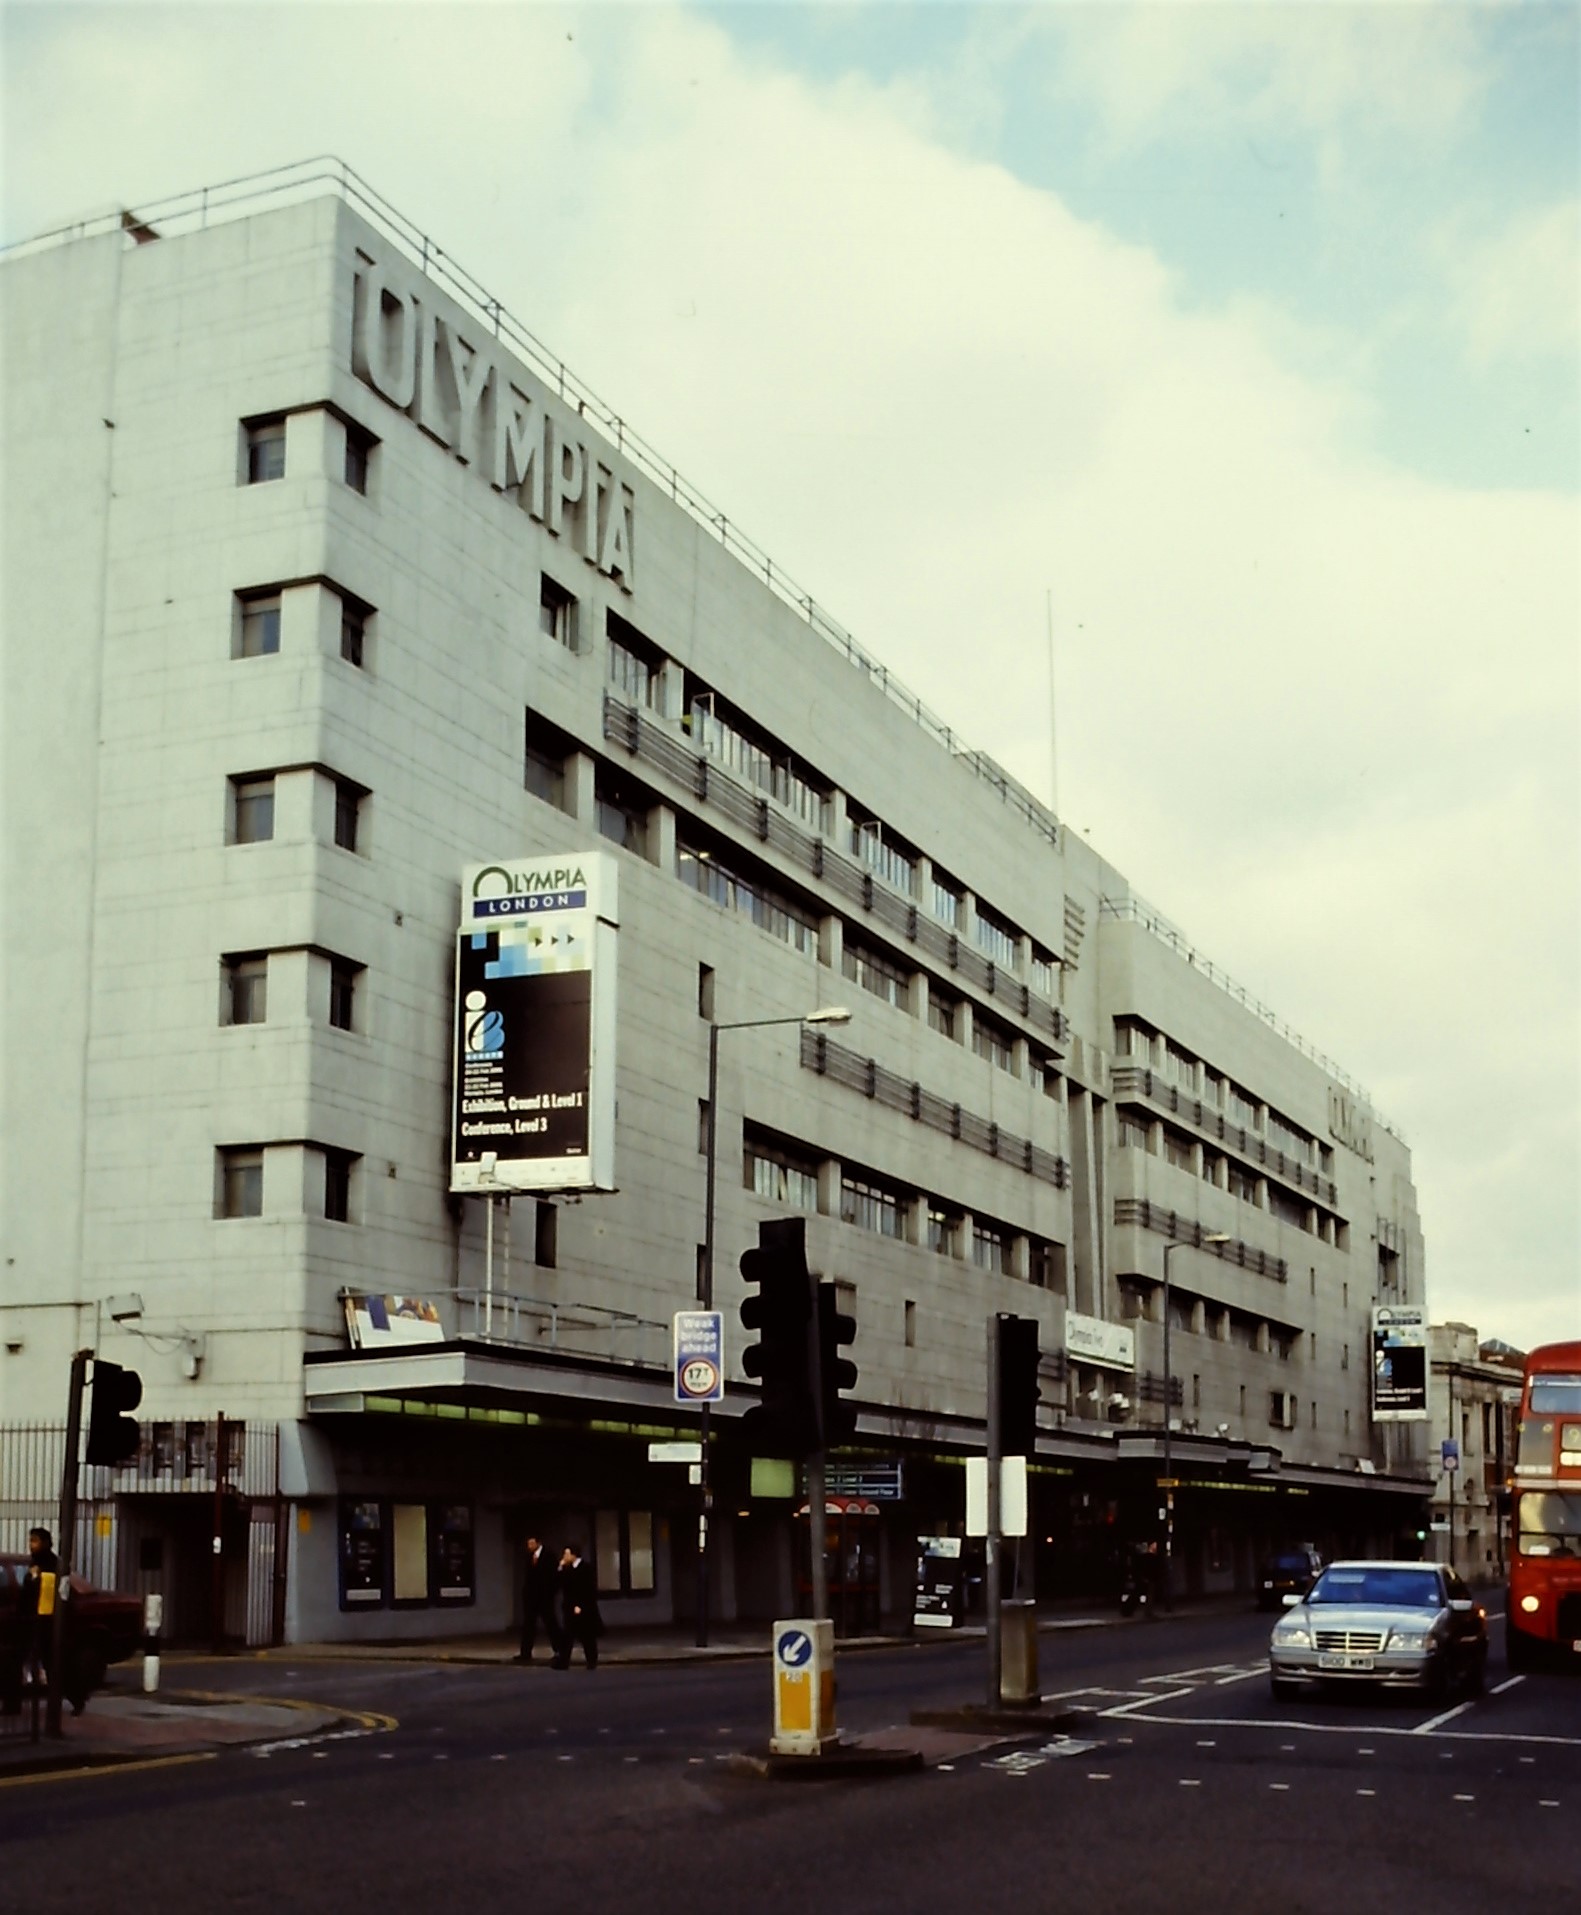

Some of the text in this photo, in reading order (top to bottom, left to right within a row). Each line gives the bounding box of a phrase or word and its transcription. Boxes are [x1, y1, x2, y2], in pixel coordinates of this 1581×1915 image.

[351, 246, 634, 596] OLYMPIA
[472, 866, 587, 897] OLYMPIA
[489, 894, 569, 913] LONDON
[508, 1094, 540, 1111] Ground
[551, 1093, 575, 1108] Level
[515, 1118, 539, 1133] Level
[540, 1117, 547, 1132] 3
